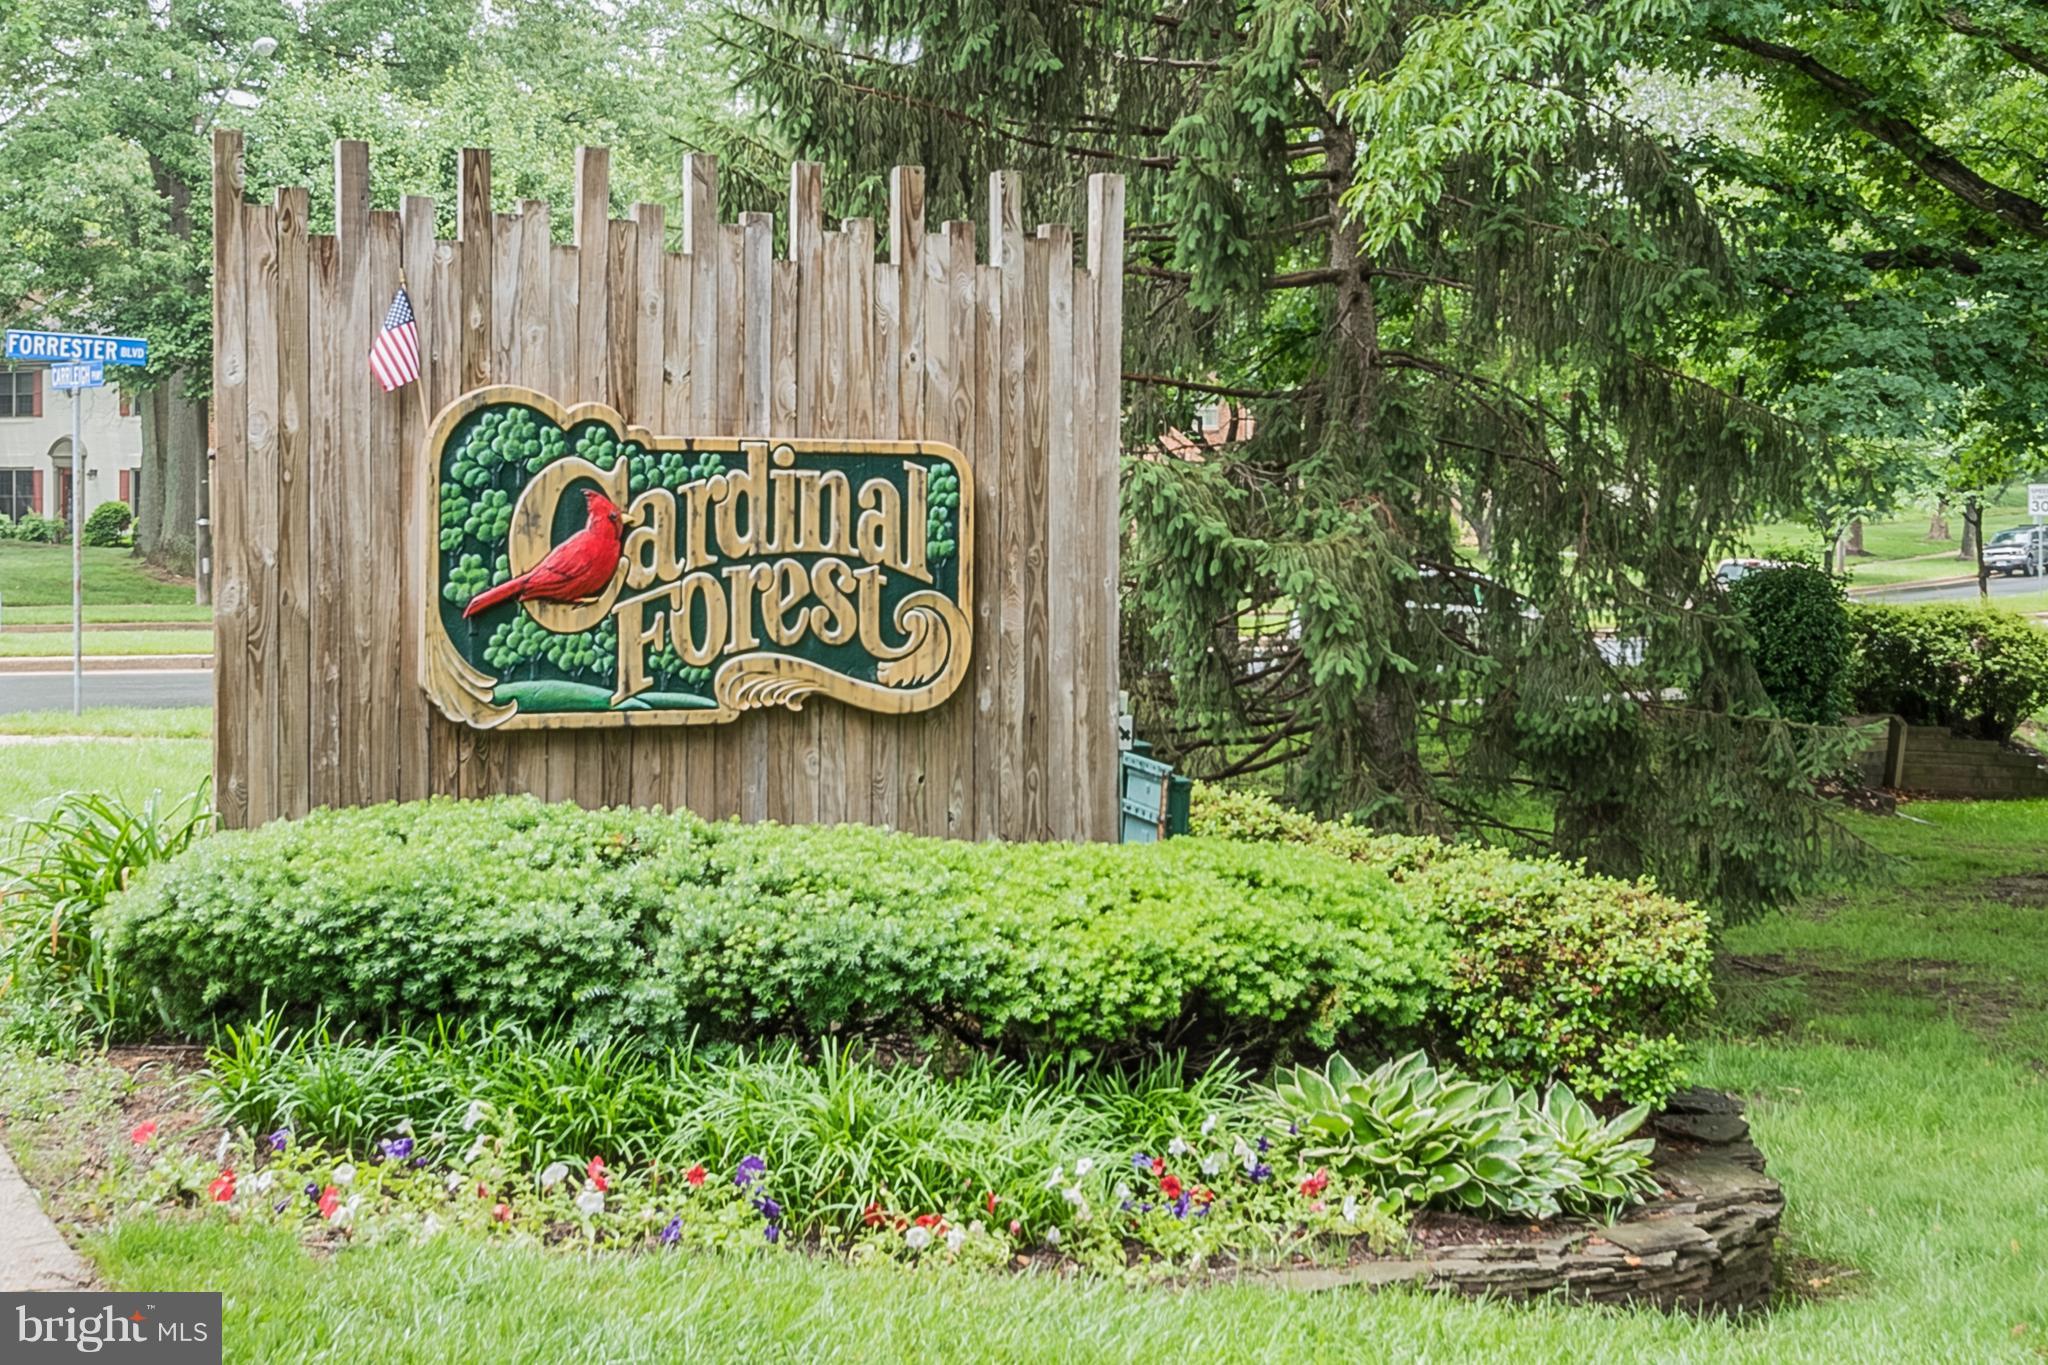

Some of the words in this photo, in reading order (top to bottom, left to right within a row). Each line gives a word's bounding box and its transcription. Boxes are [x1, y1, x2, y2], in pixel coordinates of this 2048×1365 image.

[8, 333, 118, 361] FORRESTER
[120, 346, 145, 359] BLVD
[508, 440, 934, 635] Cardinal
[2032, 500, 2048, 512] 30
[611, 557, 924, 707] Forest
